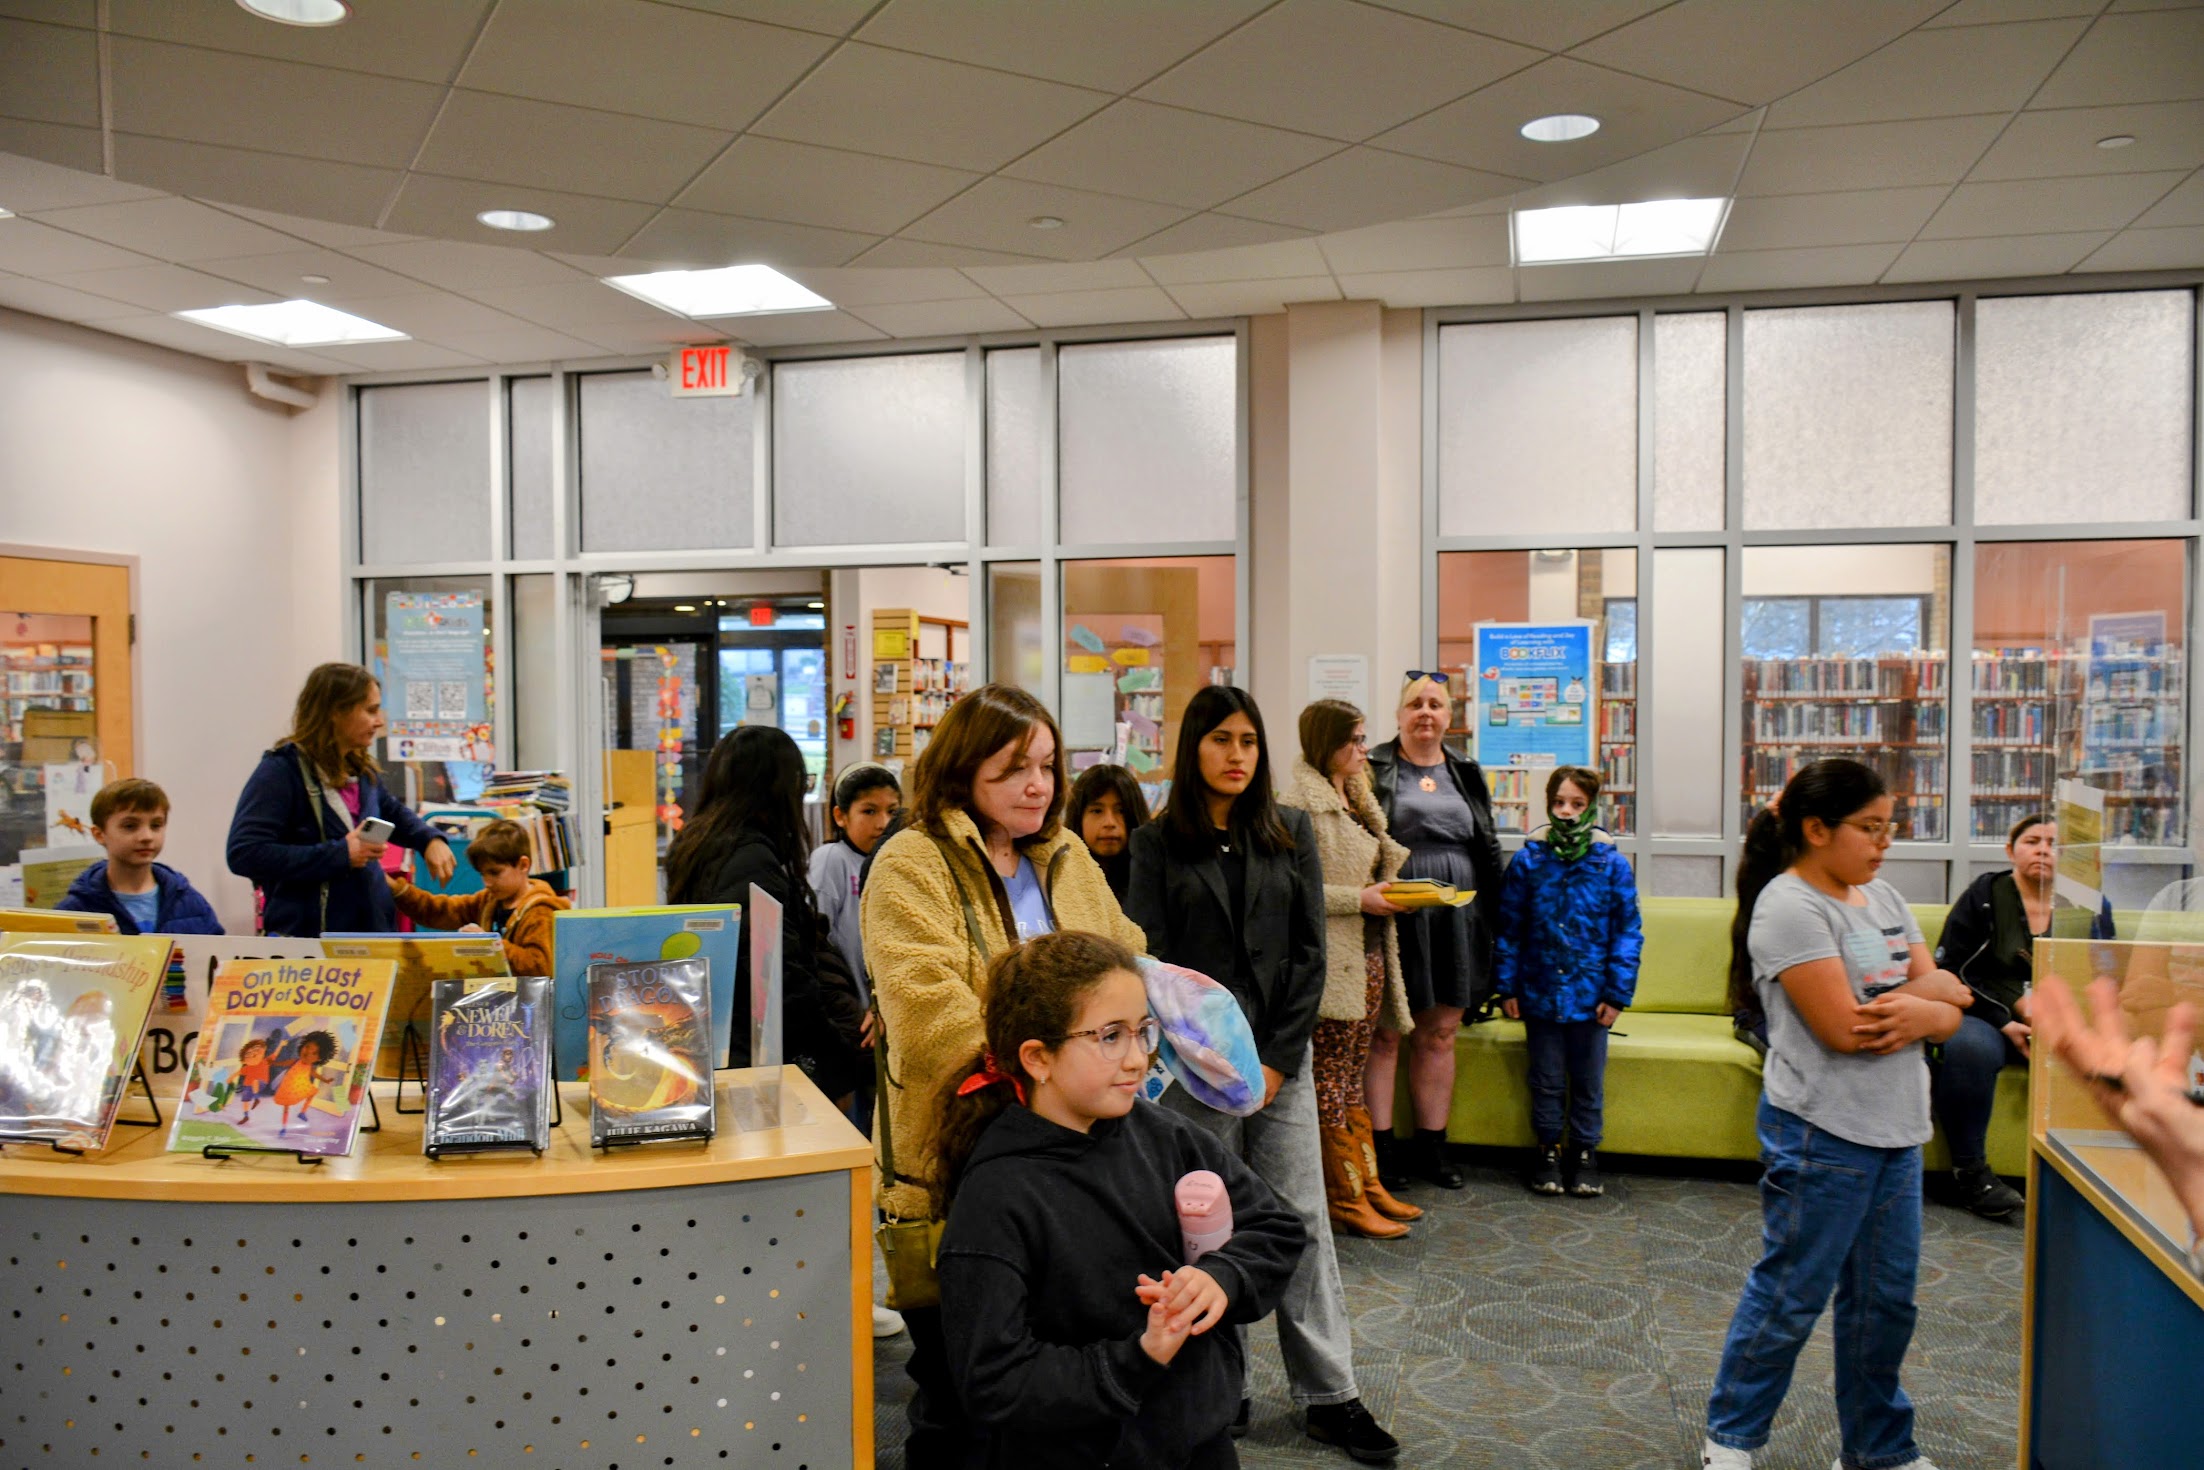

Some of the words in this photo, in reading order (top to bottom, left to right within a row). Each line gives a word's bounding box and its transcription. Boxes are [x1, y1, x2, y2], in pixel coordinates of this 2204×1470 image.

[682, 347, 730, 389] EXIT
[1500, 647, 1566, 660] BOOKFLIX
[243, 971, 273, 989] On
[278, 965, 313, 983] the
[315, 965, 361, 987] Last
[227, 988, 274, 1010] Day
[275, 989, 292, 1001] of
[293, 985, 373, 1011] School
[599, 986, 703, 1014] DRAGOS
[467, 1021, 531, 1039] DOREN
[645, 1123, 696, 1134] KAGAWA
